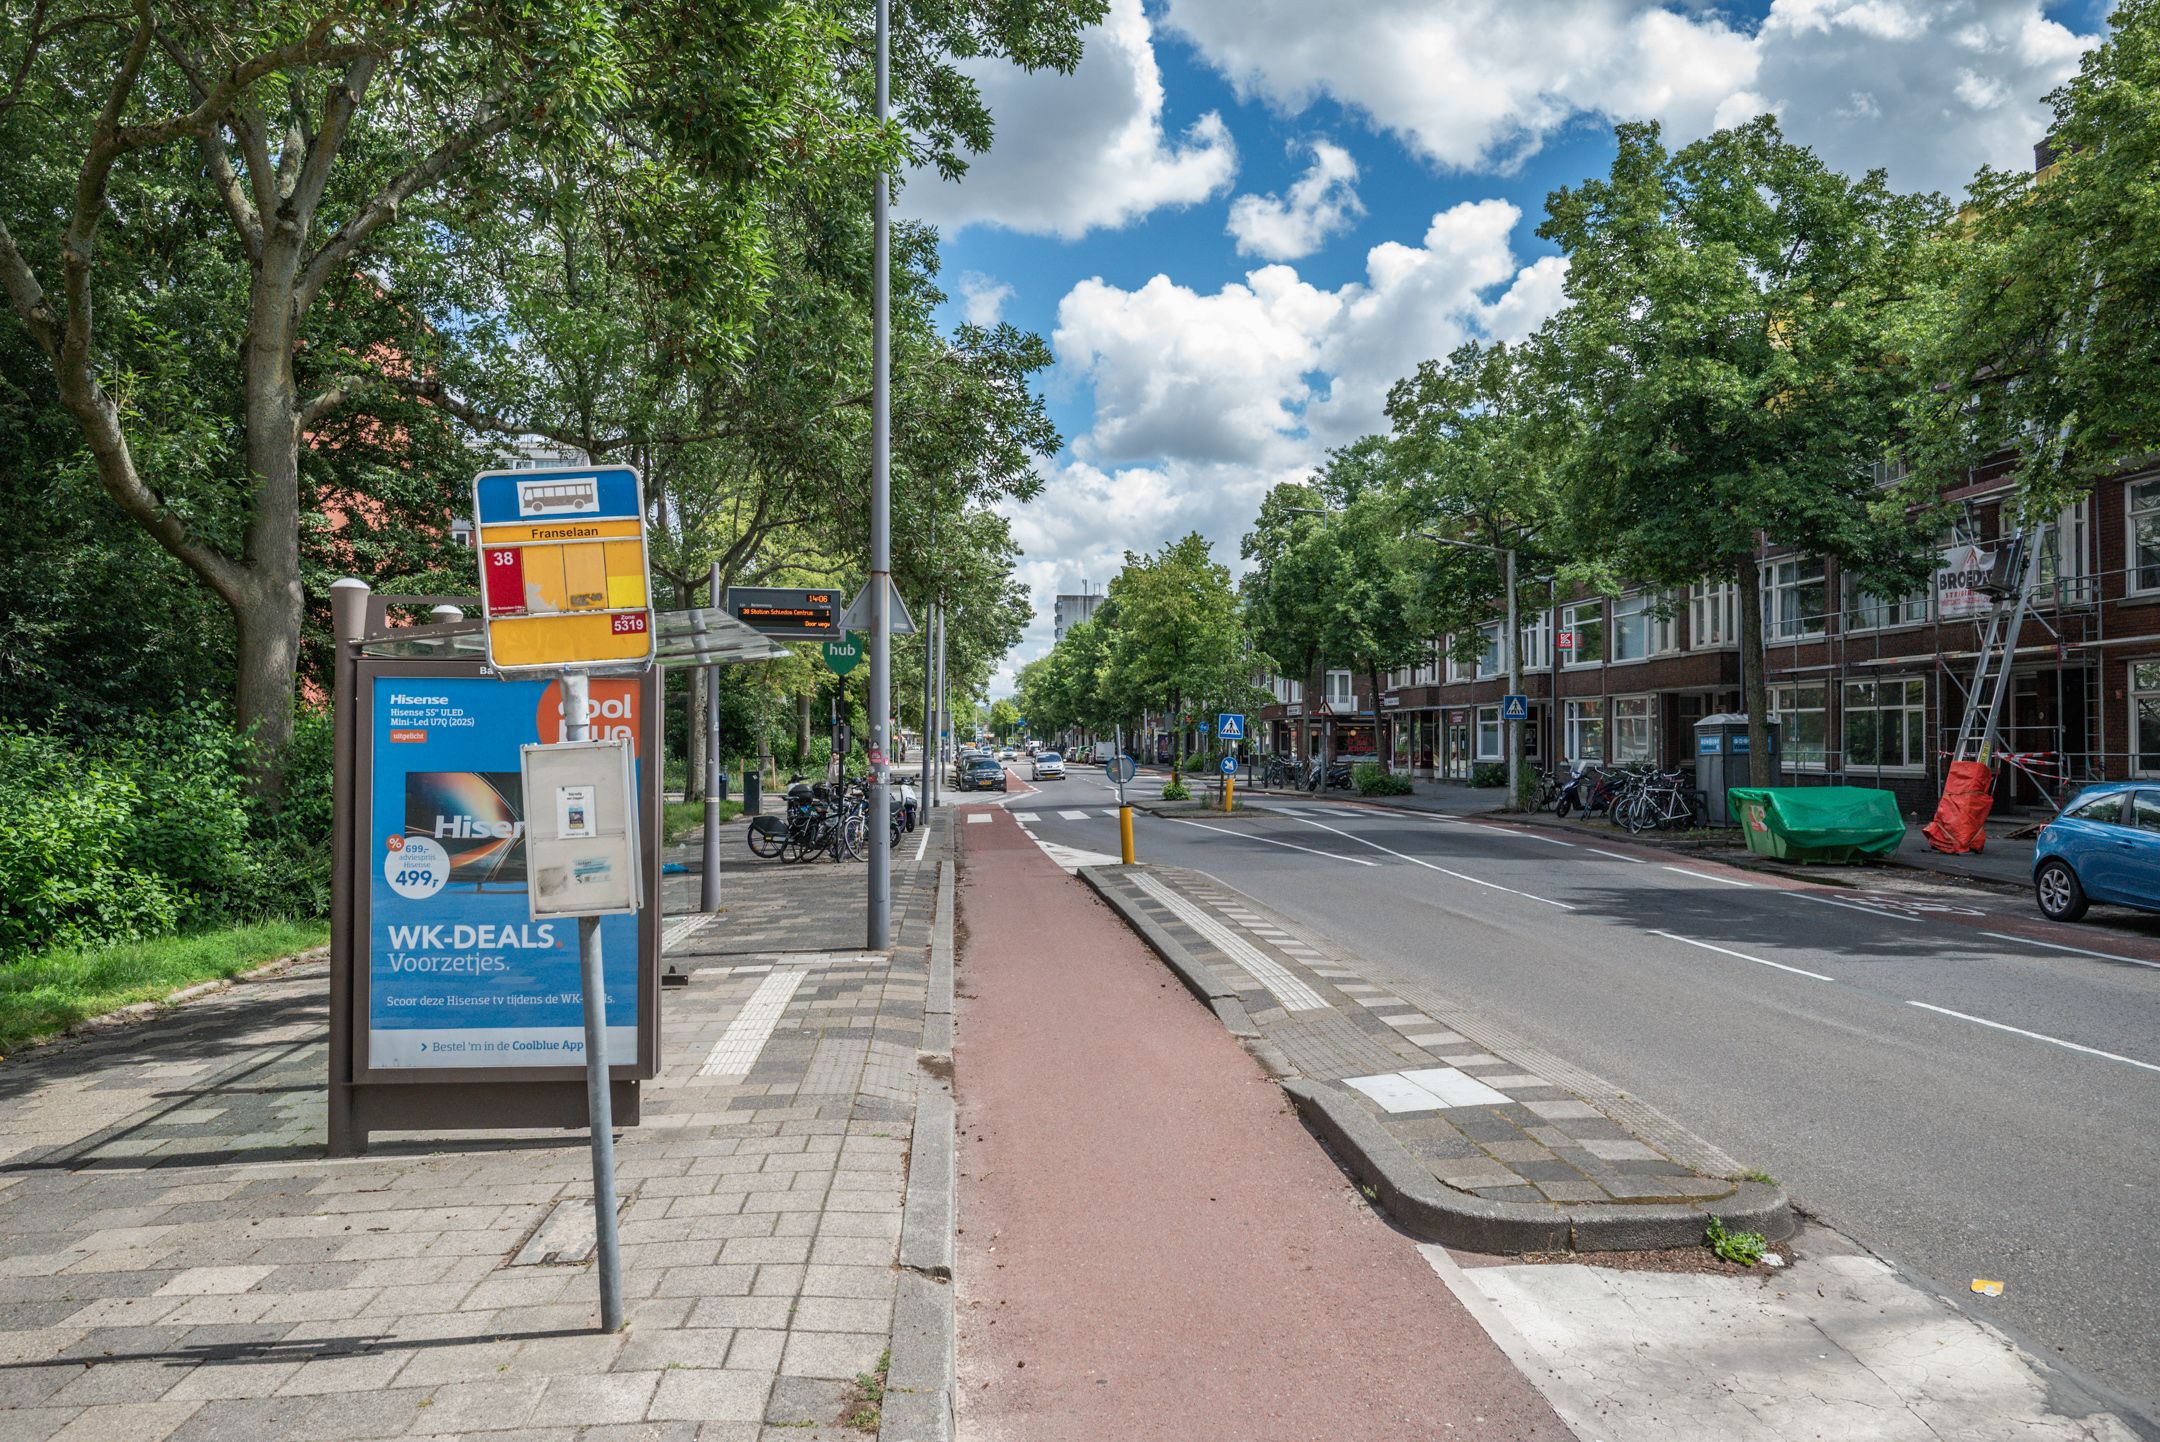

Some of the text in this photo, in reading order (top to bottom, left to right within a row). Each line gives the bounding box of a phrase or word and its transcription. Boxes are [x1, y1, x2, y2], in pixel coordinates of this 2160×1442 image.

[531, 527, 599, 539] Franselaan
[493, 552, 514, 566] 38
[614, 619, 644, 632] 5319
[829, 642, 856, 657] hub
[390, 694, 449, 705] Hisense
[558, 694, 632, 718] ool
[390, 708, 464, 717] Hisense 55" ULED
[390, 717, 475, 728] Mini-Led U7Q (2025)
[393, 732, 424, 741] uitgelicht
[405, 844, 429, 853] 699,-
[388, 924, 564, 950] WK-DEALS.
[388, 952, 511, 976] Voorzetjes.
[386, 996, 417, 1007] Scoor
[420, 995, 445, 1006] deze
[447, 995, 491, 1006] Hisense
[492, 996, 505, 1005] tv
[507, 994, 542, 1007] tijdens
[545, 994, 558, 1004] de
[432, 1040, 584, 1053] Bestel 'm in de Coolblue App
